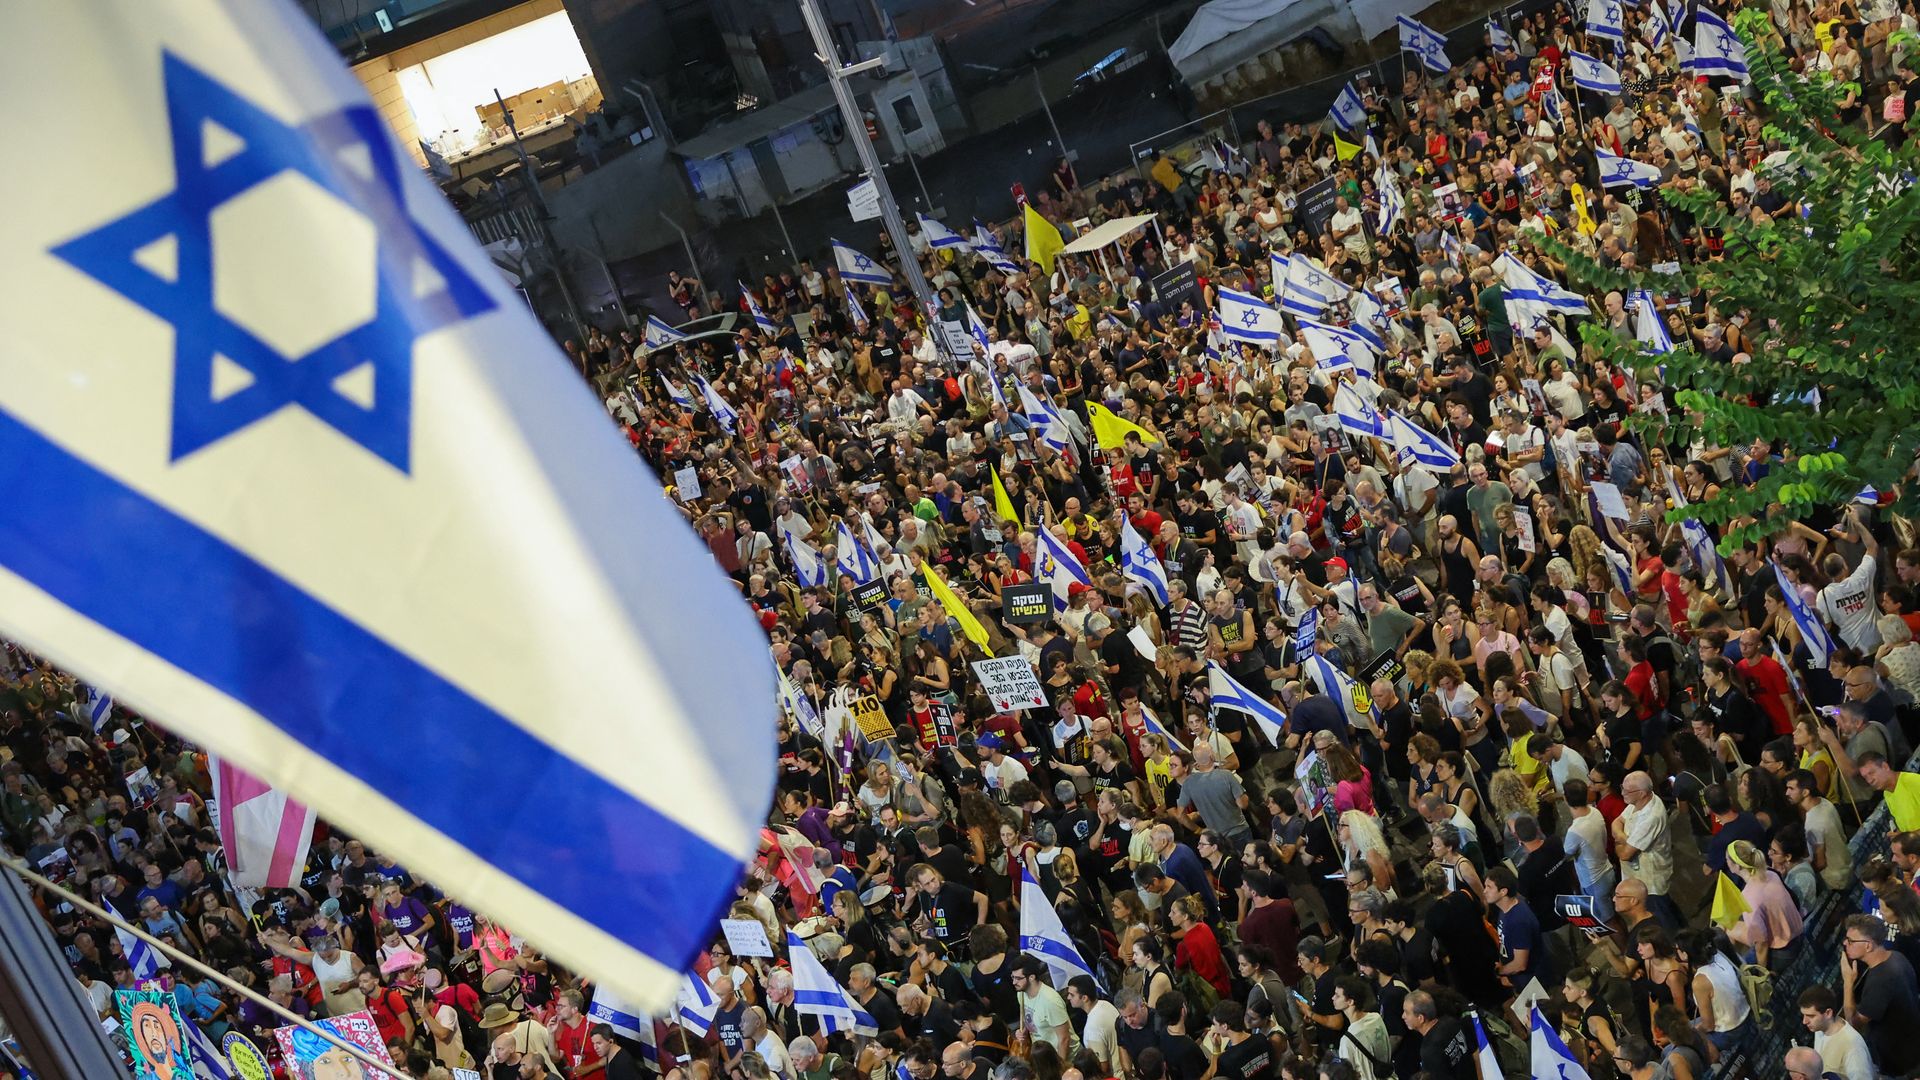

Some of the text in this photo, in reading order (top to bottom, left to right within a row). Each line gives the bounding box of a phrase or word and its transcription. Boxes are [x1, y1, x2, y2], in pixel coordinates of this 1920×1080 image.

[860, 585, 881, 599] עסקה
[1012, 594, 1043, 606] עסקה
[1011, 604, 1047, 617] עכשיו!
[1005, 658, 1027, 670] נתניהו
[1371, 658, 1395, 680] עסקה
[990, 670, 1033, 683] הצביעו בעד
[986, 681, 1040, 695] הפקרת החטופים
[1009, 691, 1032, 706] למוות
[847, 697, 880, 717] 7.10
[1565, 903, 1582, 917] עם
[352, 1020, 368, 1030] לירי
[454, 1067, 480, 1080] STOP
